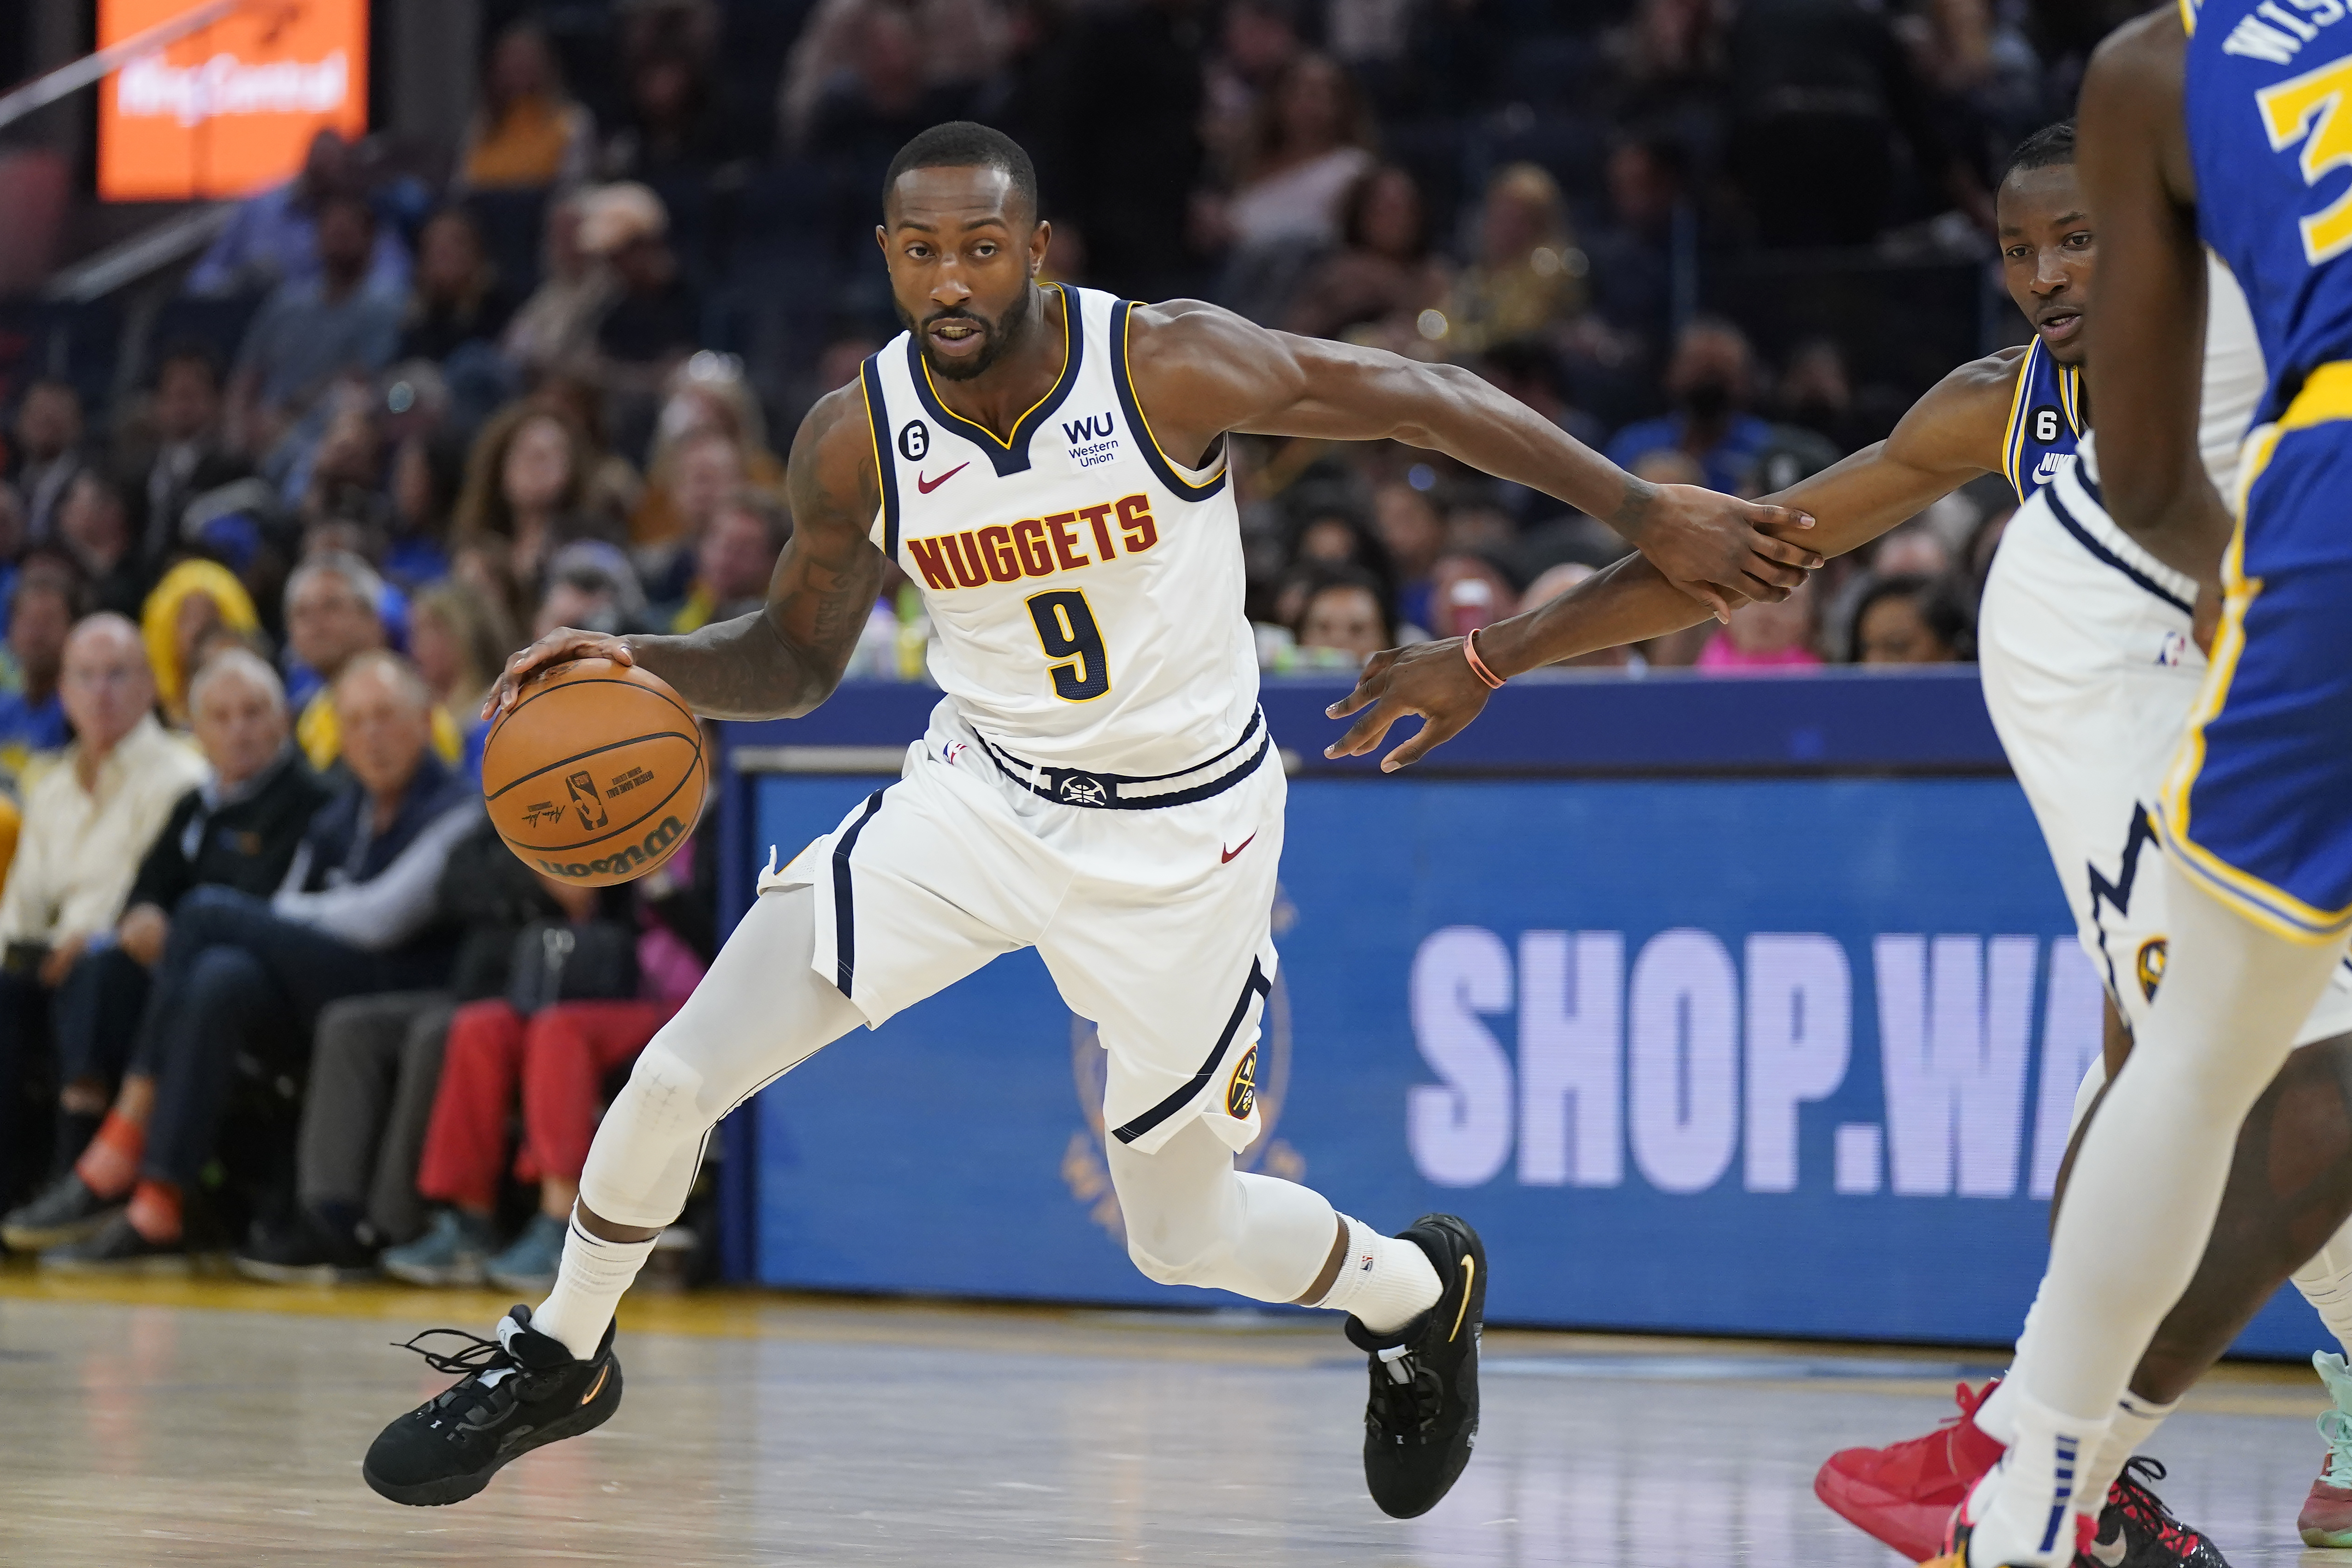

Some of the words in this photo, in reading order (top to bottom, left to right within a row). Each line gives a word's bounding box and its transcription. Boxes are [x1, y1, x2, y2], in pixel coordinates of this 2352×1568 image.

[2222, 0, 2352, 66] WIS
[907, 425, 923, 456] 6
[1062, 412, 1113, 444] WU
[2036, 411, 2057, 440] 6
[1068, 440, 1118, 459] Western
[1080, 453, 1114, 467] Union
[2039, 452, 2077, 472] NIK
[906, 492, 1158, 591] NUGGETS
[1024, 586, 1112, 704] 9
[536, 815, 686, 877] Wilson
